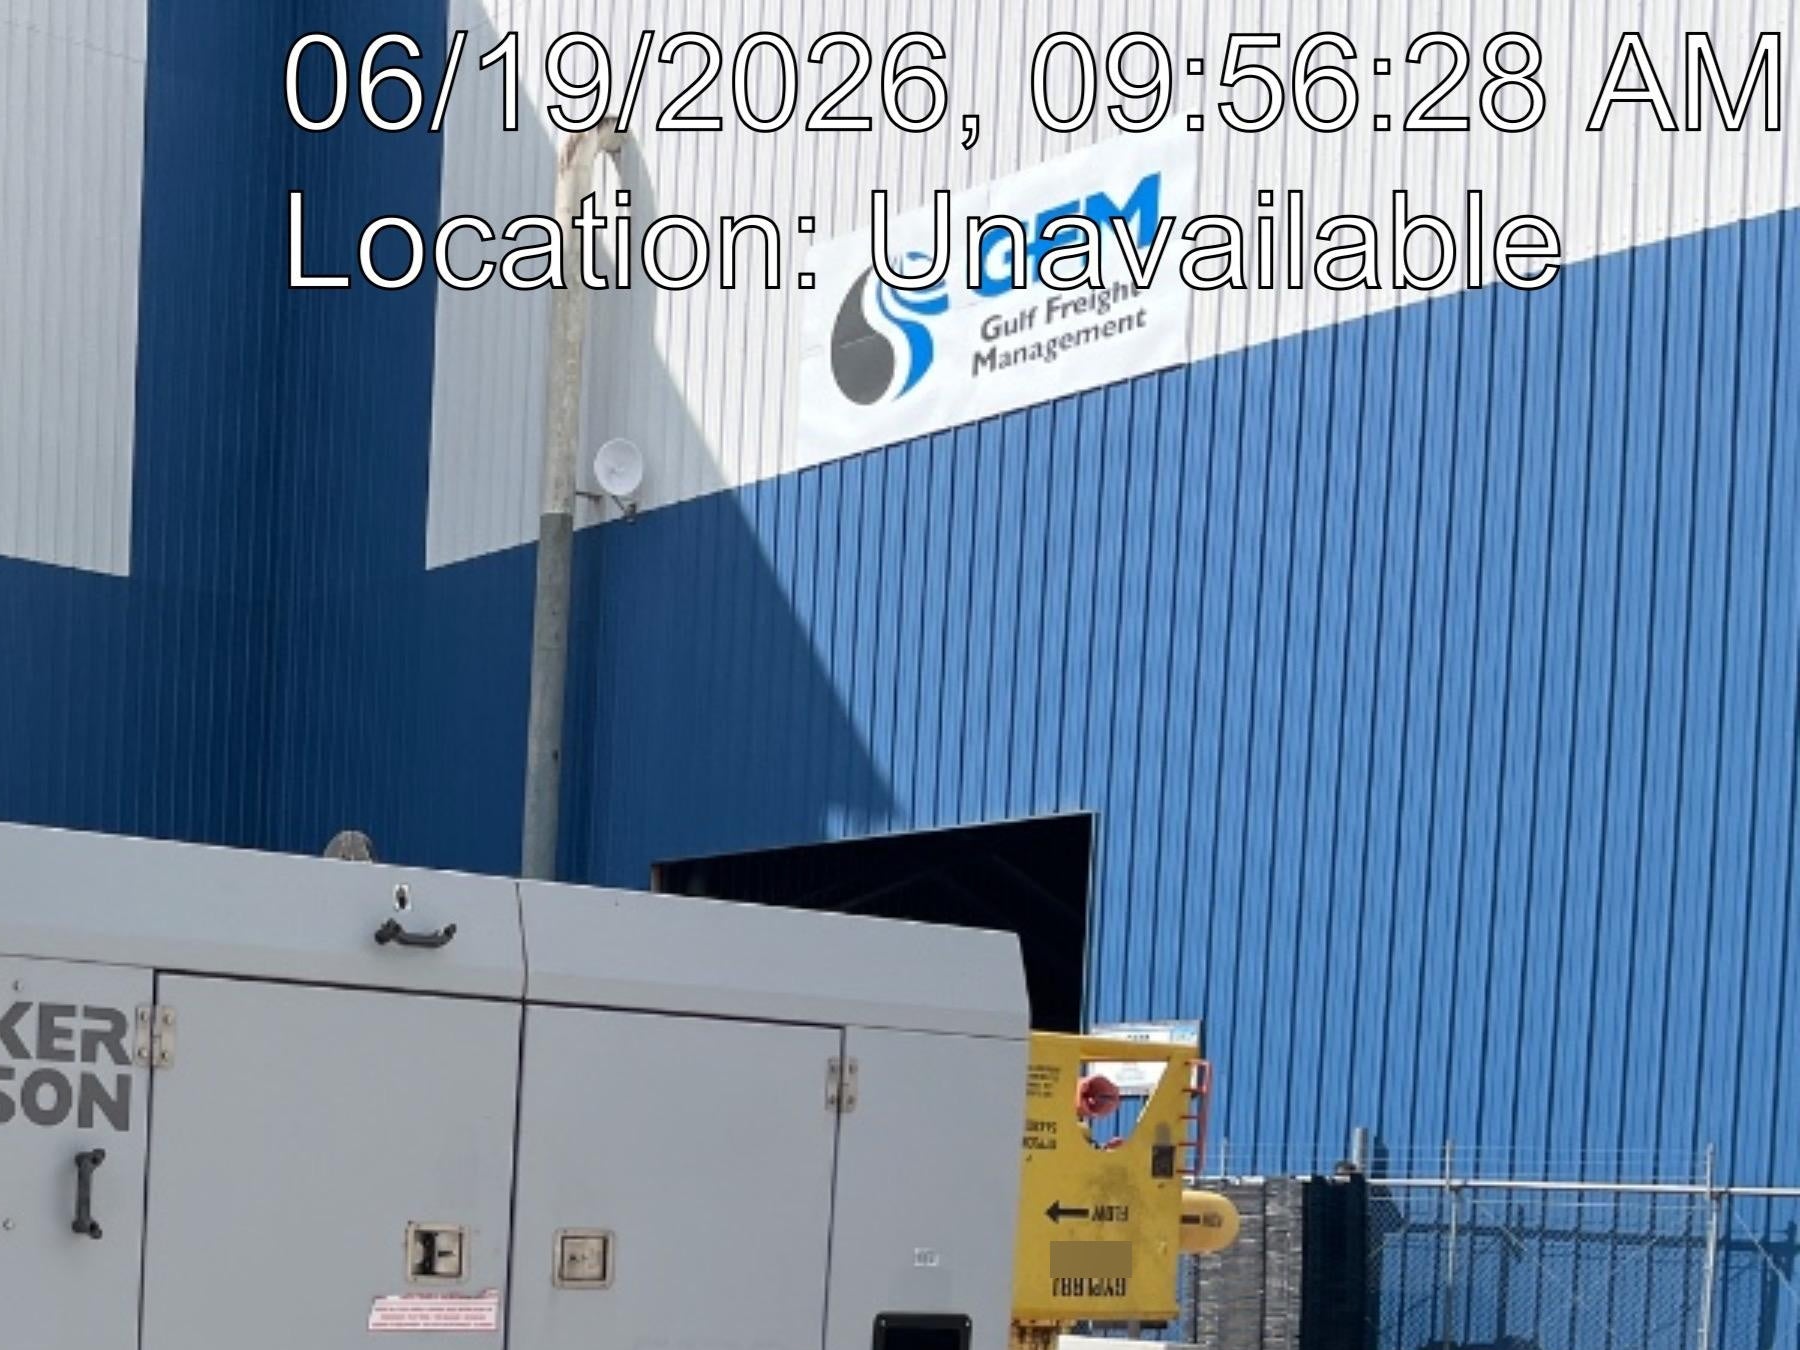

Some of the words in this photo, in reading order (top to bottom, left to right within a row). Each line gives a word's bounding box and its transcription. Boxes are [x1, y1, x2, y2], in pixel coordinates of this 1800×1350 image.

[971, 307, 1149, 378] Management
[979, 304, 1038, 343] Gulf
[1044, 280, 1143, 327] Freight
